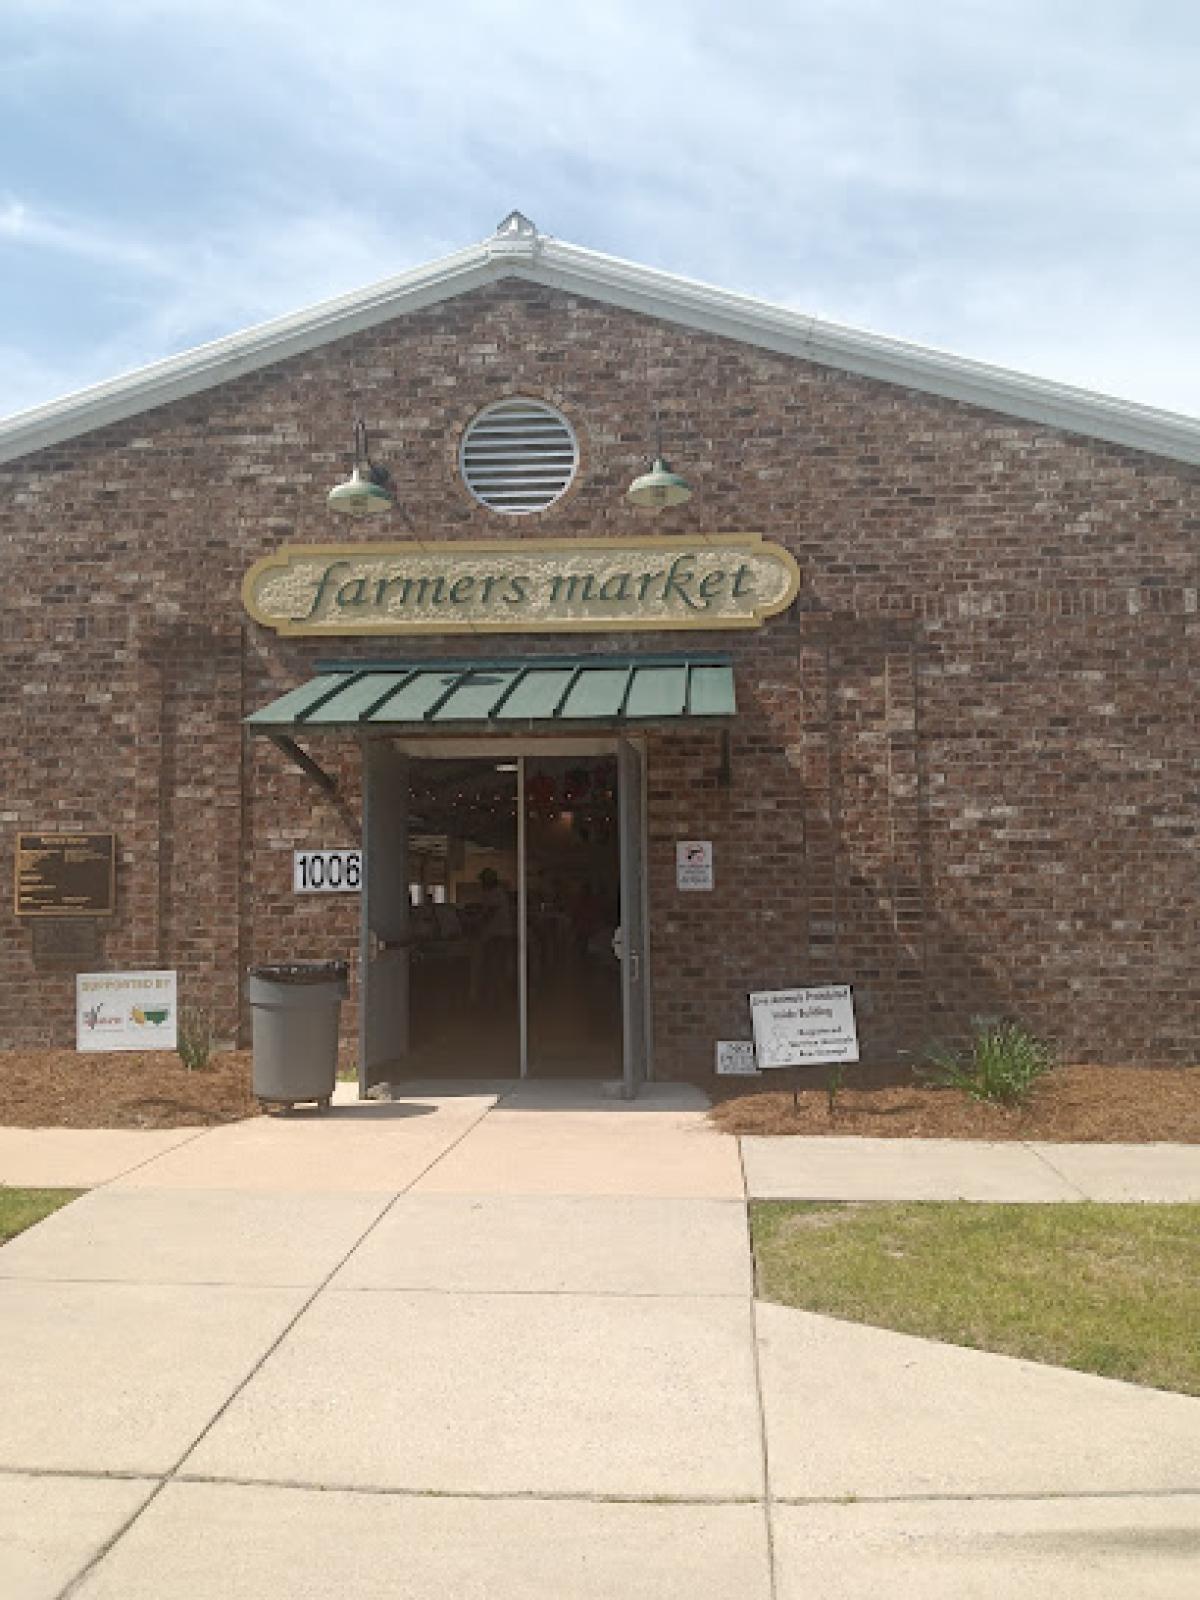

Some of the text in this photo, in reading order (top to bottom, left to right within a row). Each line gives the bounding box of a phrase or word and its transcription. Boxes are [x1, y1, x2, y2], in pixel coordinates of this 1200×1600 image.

[290, 554, 753, 621] farmers market
[298, 853, 361, 888] 1006
